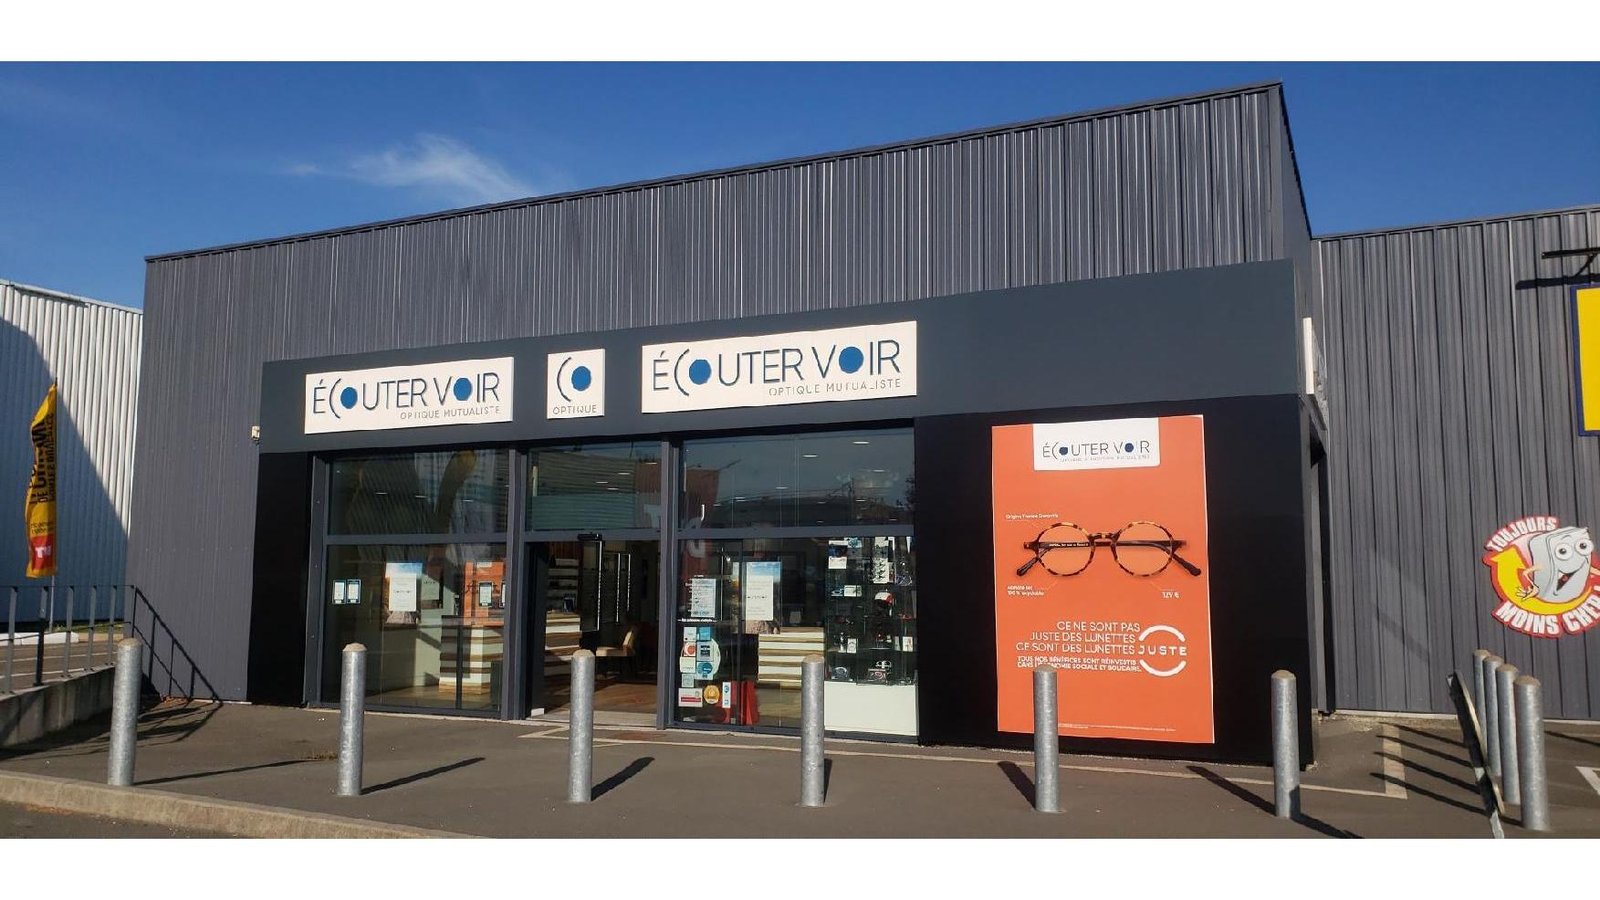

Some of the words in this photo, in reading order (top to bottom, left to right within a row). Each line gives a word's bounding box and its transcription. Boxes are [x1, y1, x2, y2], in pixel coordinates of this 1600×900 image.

[653, 348, 805, 397] ÉCOUTER
[811, 339, 901, 379] VOIR
[313, 377, 427, 419] ÉCOUTER
[433, 372, 500, 406] VOIR
[769, 384, 820, 397] OPTIQUE
[826, 378, 901, 392] MUTUALISTE
[400, 410, 440, 420] OPTIQUE
[443, 405, 500, 418] MUTUALISTE
[552, 404, 598, 415] OPTIQUE
[1042, 441, 1109, 460] ÉCOUTER
[1486, 516, 1558, 552] TOUJOURS
[1495, 600, 1560, 635] MOINS
[1056, 621, 1072, 631] CE
[1073, 621, 1087, 631] NE
[1089, 621, 1118, 632] SONT
[1121, 622, 1141, 633] PAS
[1030, 632, 1060, 641] JUSTE
[1062, 632, 1082, 642] DES
[1084, 633, 1136, 644] LUNETTES
[1031, 643, 1060, 652] SONT
[1062, 643, 1082, 653] DES
[1084, 644, 1136, 655] LUNETTES
[1138, 644, 1187, 656] JUSTE
